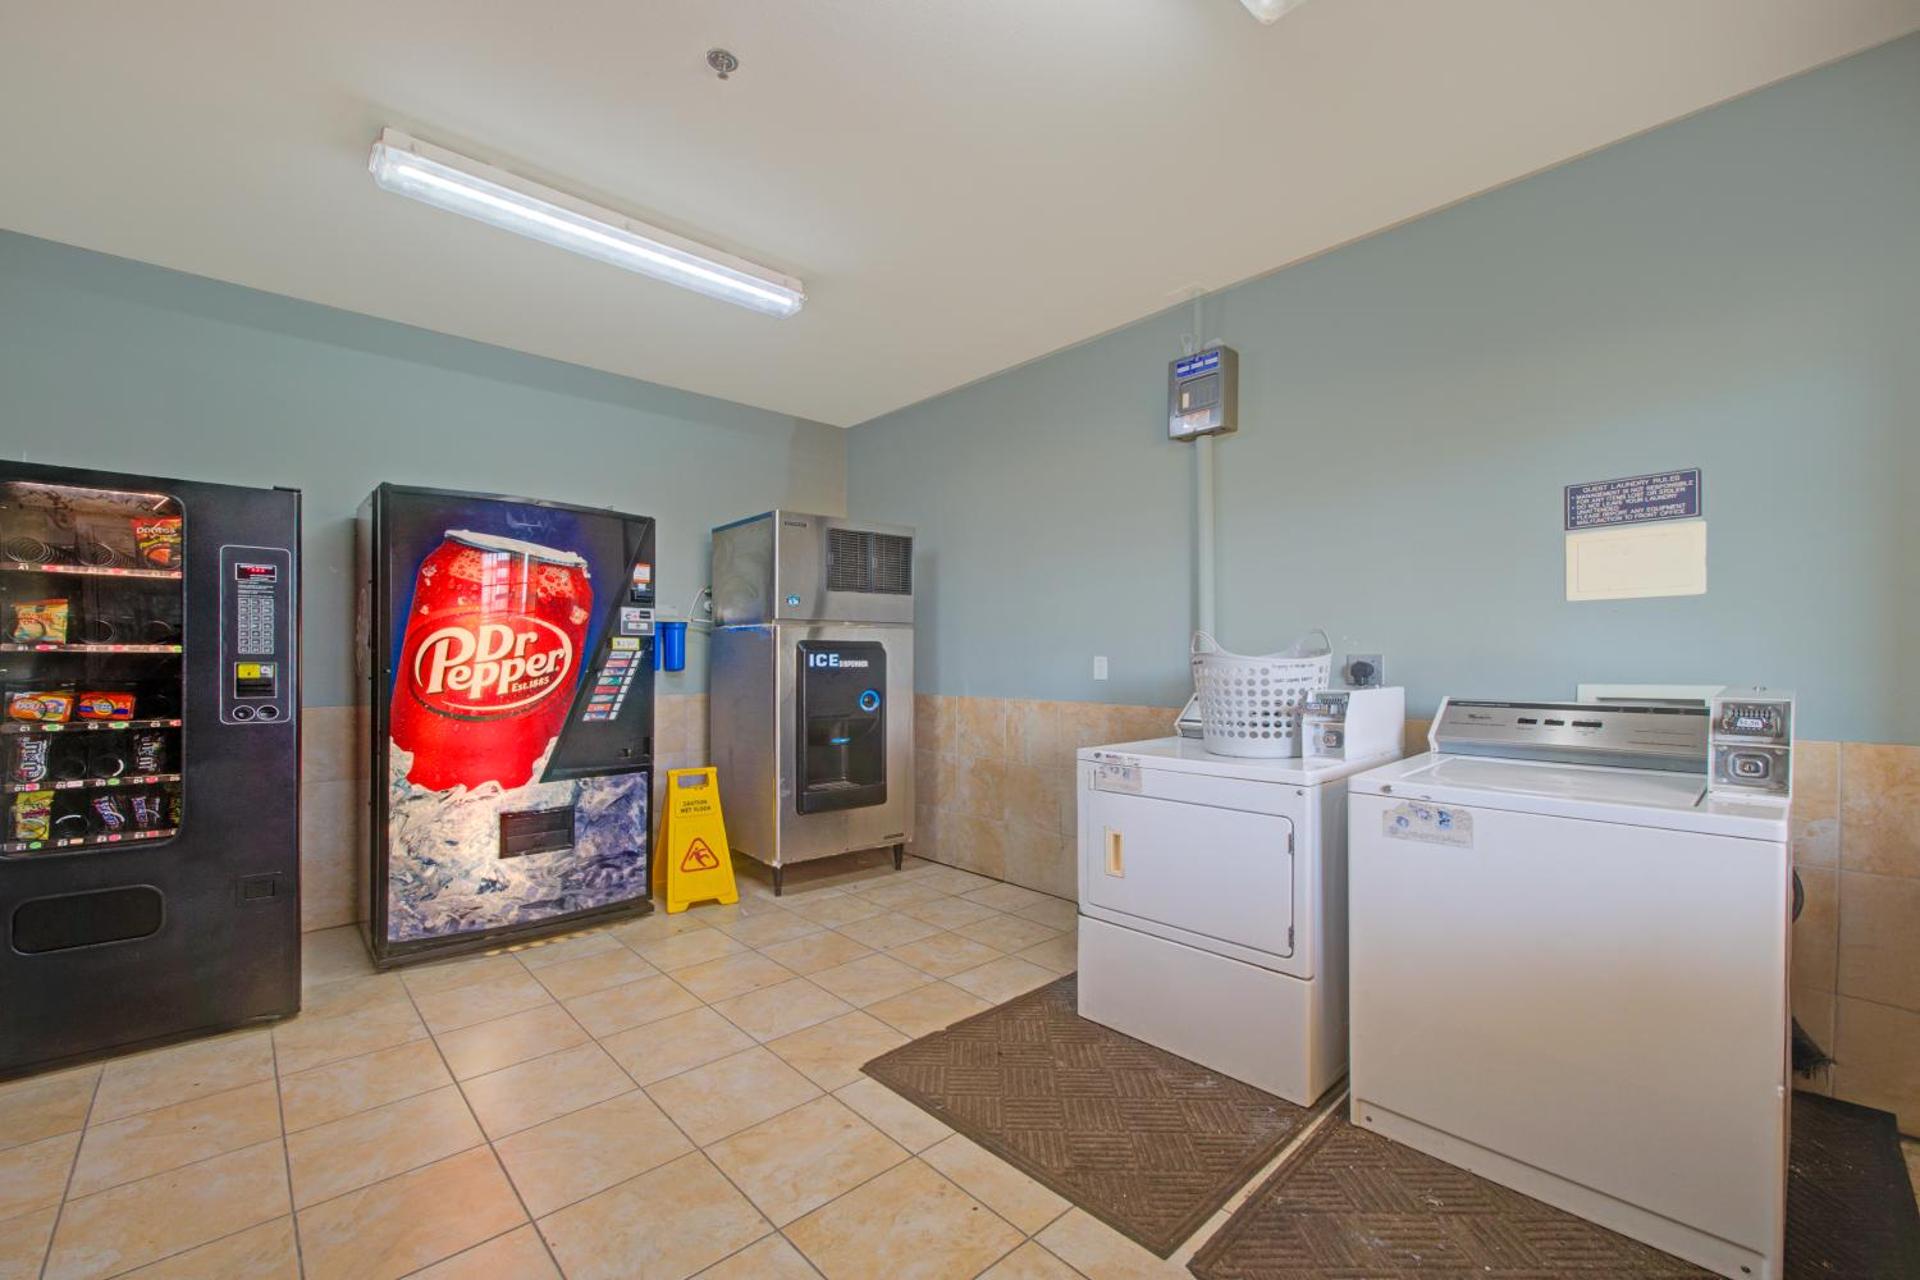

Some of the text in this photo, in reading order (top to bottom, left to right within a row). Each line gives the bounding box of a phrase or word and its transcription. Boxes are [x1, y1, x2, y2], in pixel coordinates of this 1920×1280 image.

[1576, 489, 1620, 499] MANAGEMENT
[1645, 480, 1693, 490] RESPONSIBLE
[1582, 476, 1680, 493] GUEST LAUNDRY RULES
[1644, 493, 1677, 501] LAUNDRY
[1645, 503, 1686, 512] EQUIPMENT
[475, 624, 538, 662] Dr
[415, 626, 564, 699] Pepper
[809, 653, 839, 667] ICE
